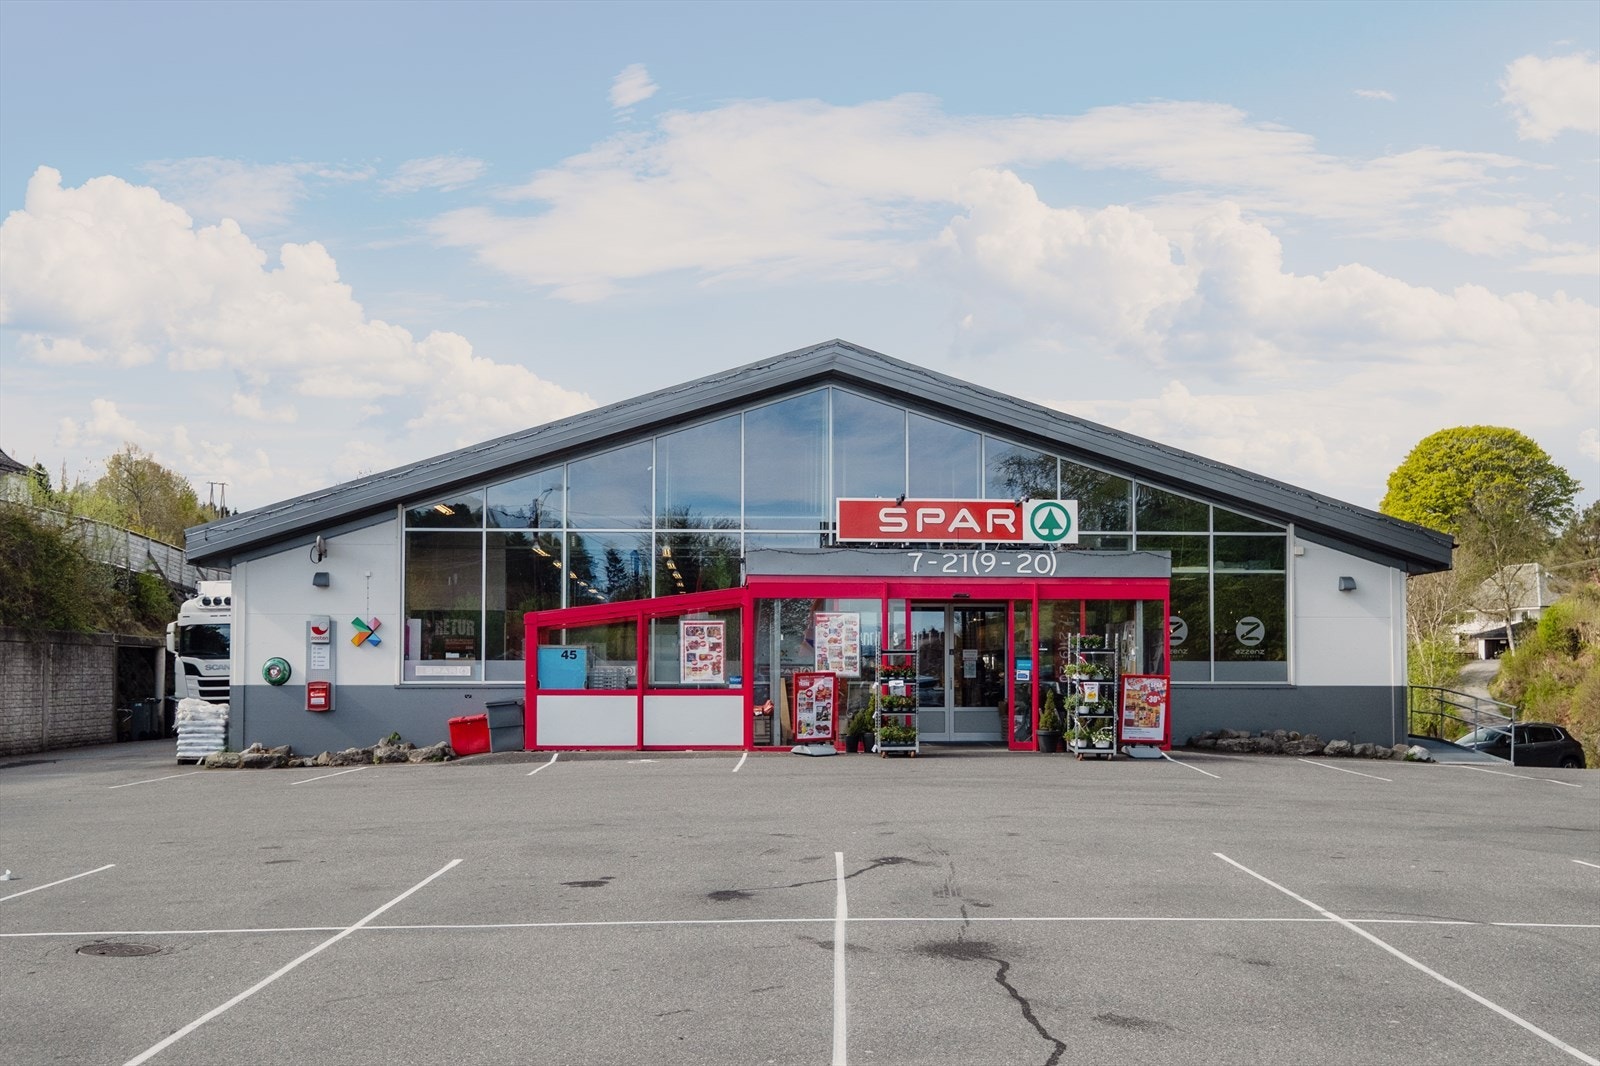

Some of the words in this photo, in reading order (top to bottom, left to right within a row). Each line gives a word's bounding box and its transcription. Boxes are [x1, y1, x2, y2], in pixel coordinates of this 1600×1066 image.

[879, 507, 1017, 533] SPAR
[434, 618, 475, 635] RETUR
[561, 650, 577, 659] 45
